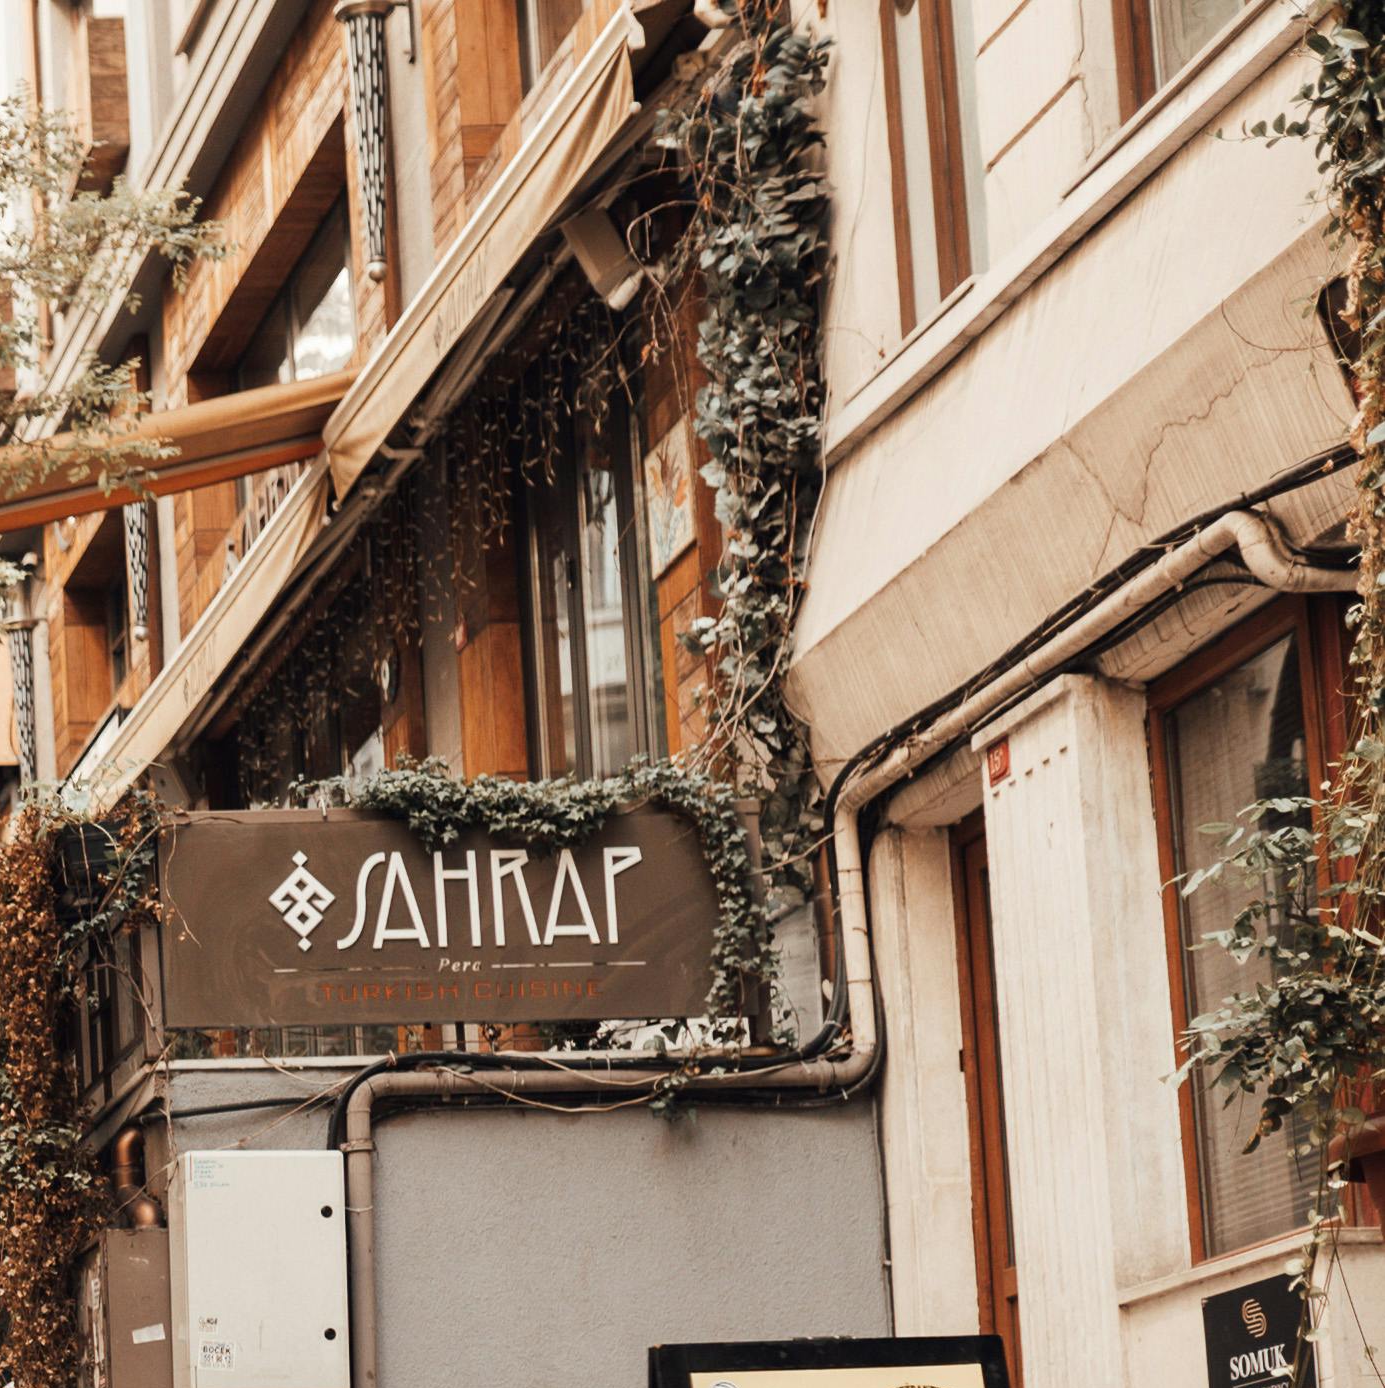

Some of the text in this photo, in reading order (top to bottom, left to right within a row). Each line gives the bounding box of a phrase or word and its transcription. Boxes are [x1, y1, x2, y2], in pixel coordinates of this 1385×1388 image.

[336, 845, 643, 950] SAHRAP
[438, 957, 482, 973] Pera
[319, 978, 605, 1002] TURKISH CUISINE
[1230, 1343, 1286, 1380] SOMUK
